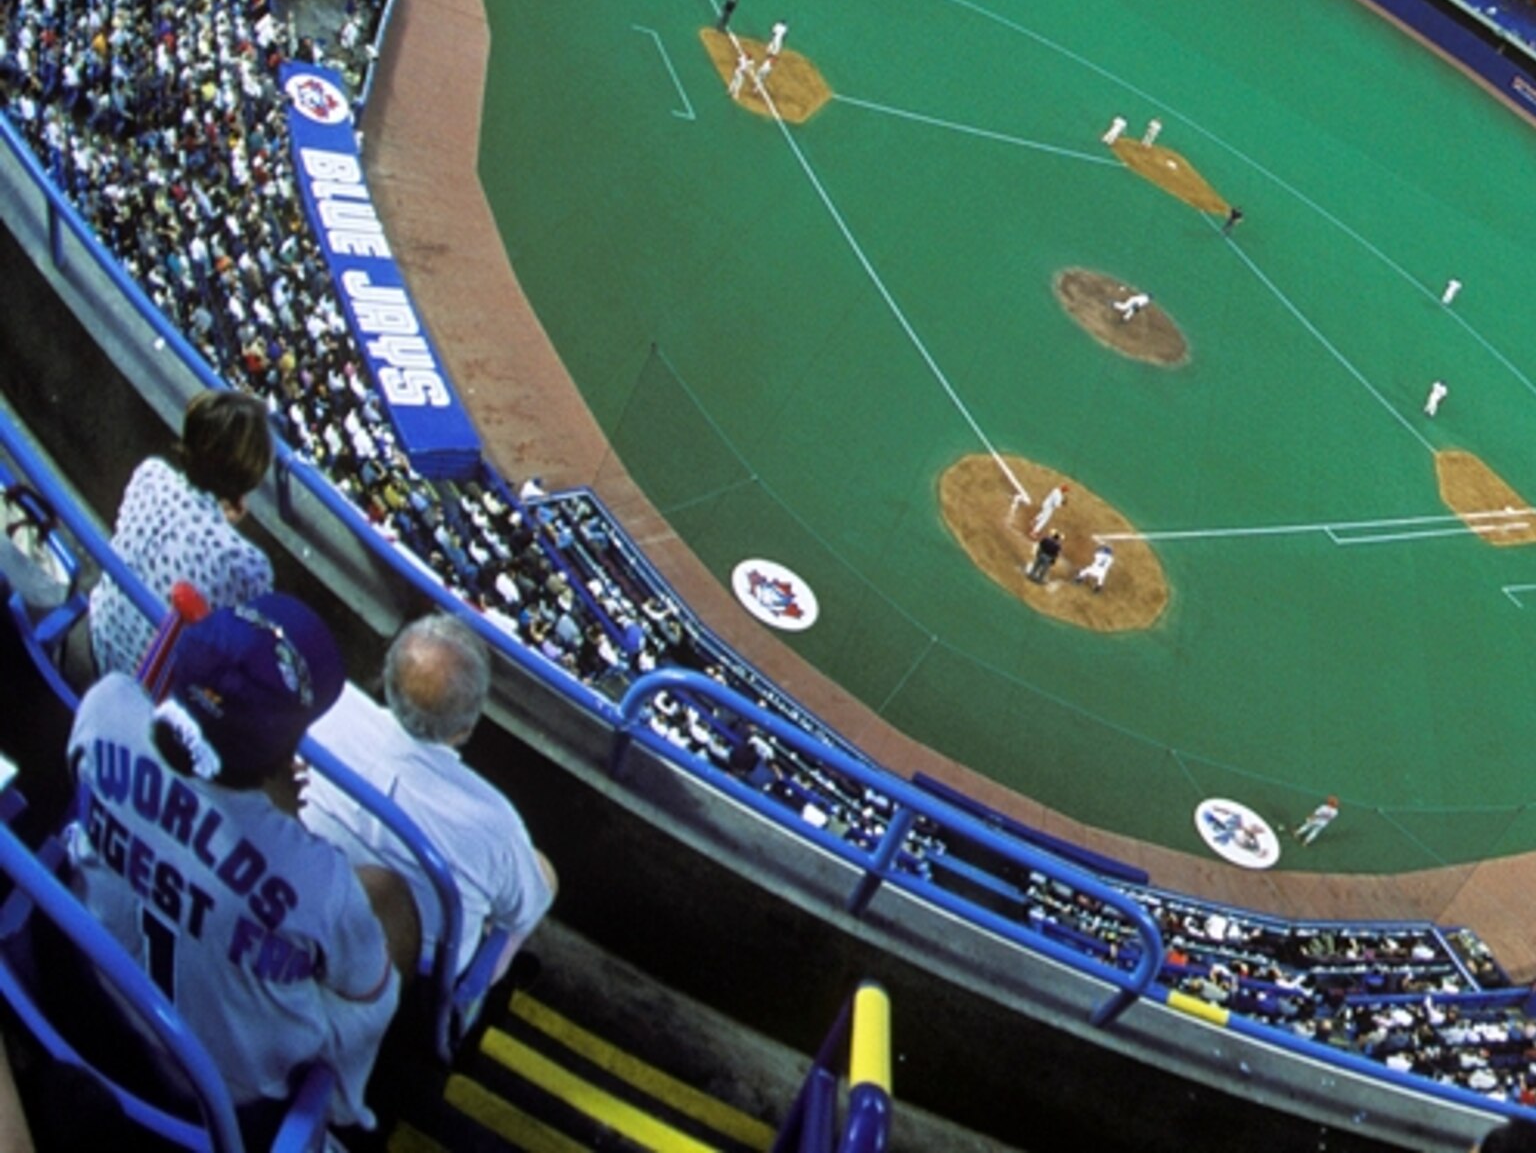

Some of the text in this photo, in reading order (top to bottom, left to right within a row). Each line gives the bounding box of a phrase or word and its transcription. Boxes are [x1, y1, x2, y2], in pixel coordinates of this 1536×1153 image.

[302, 149, 450, 406] BLUE JAYS
[95, 738, 298, 930] WORLDS
